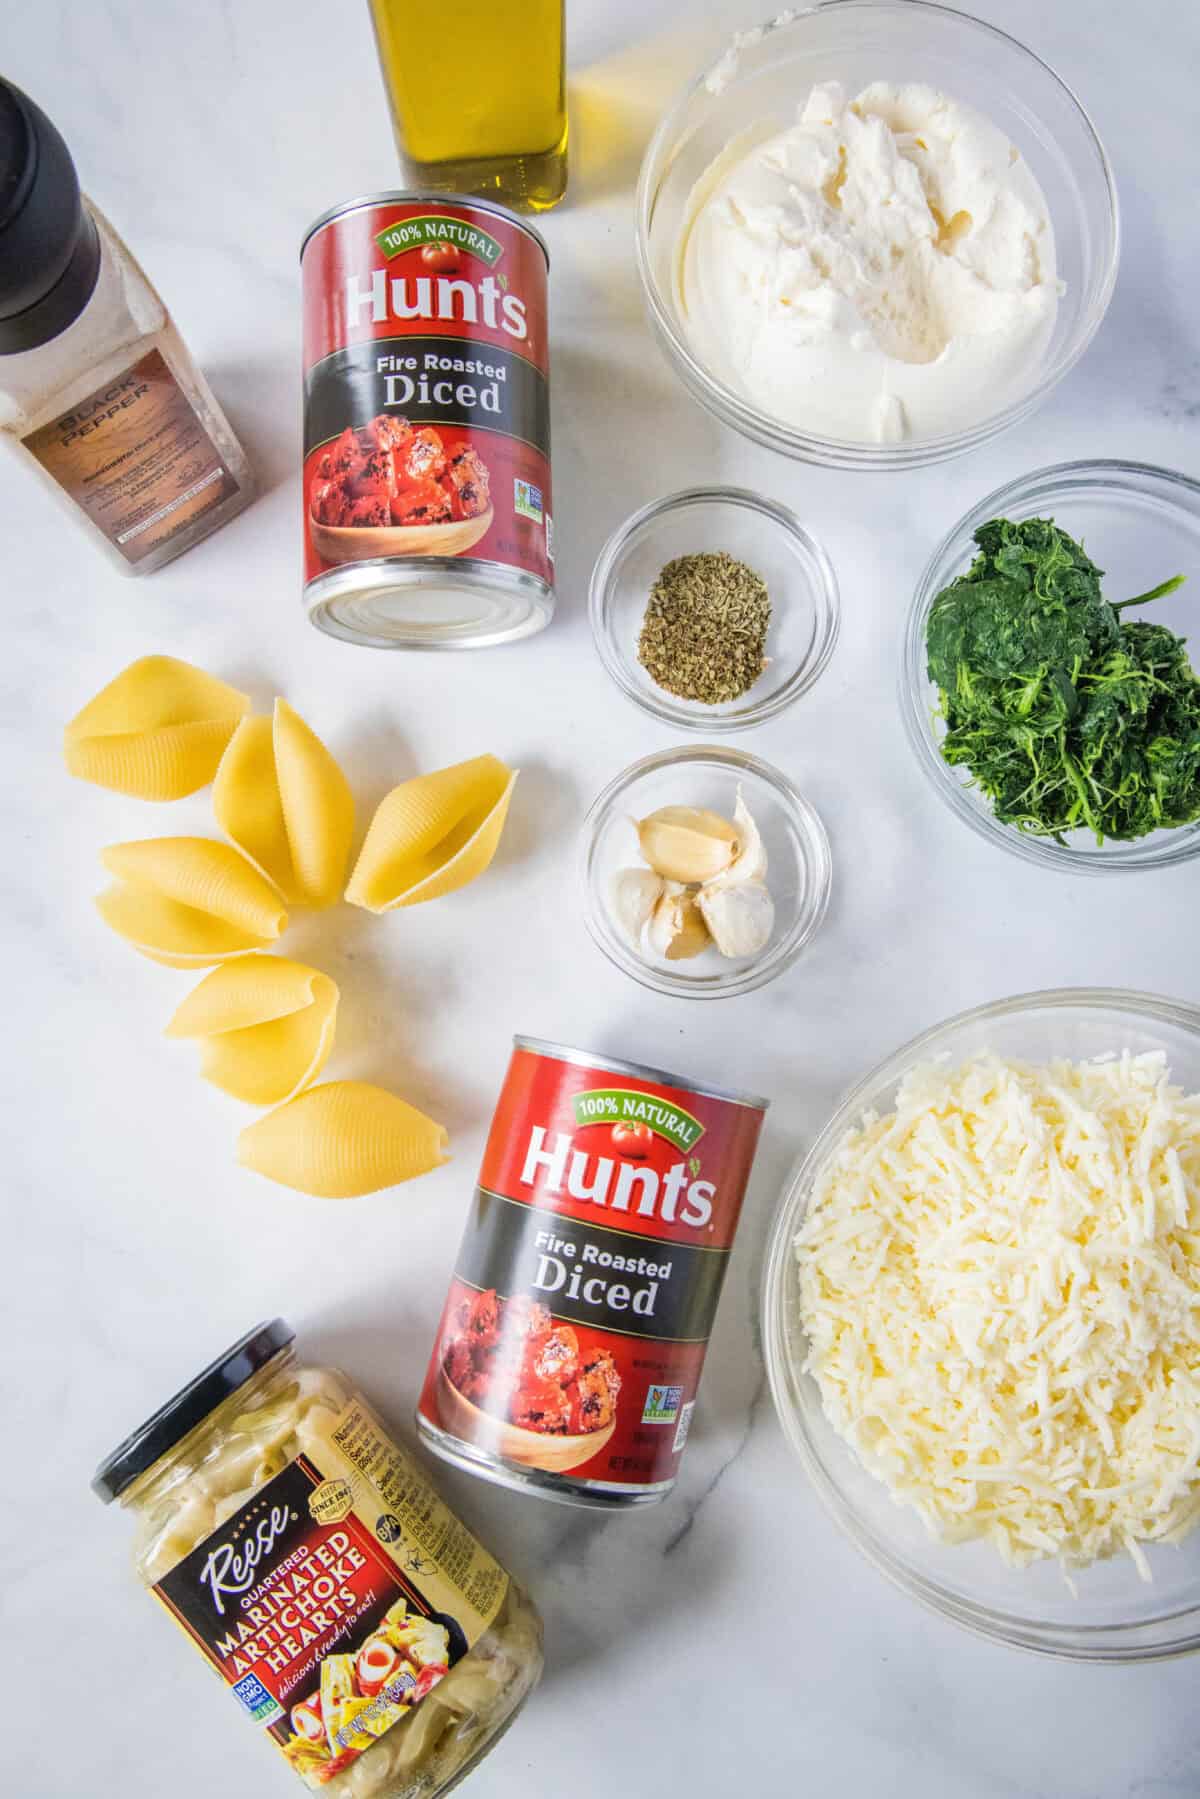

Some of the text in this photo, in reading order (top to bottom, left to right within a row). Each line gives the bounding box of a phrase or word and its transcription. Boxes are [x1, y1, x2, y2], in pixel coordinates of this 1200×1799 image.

[385, 223, 494, 259] 100% NATURAL
[347, 269, 528, 339] Hunt's
[377, 354, 506, 381] Fire Roasted
[384, 373, 502, 413] Diced
[61, 383, 150, 447] PEPPER
[579, 1097, 693, 1144] 100% NATURAL
[520, 1125, 717, 1227] Hunt's
[531, 1253, 660, 1317] Diced
[534, 1231, 673, 1280] Fire Roasted
[200, 1504, 289, 1615] Reese
[240, 1545, 309, 1609] QUARTERED
[215, 1531, 350, 1659] MARINATED
[232, 1547, 367, 1676] ARTICHOKE
[264, 1586, 357, 1674] HEARTS
[278, 1657, 316, 1700] delicious
